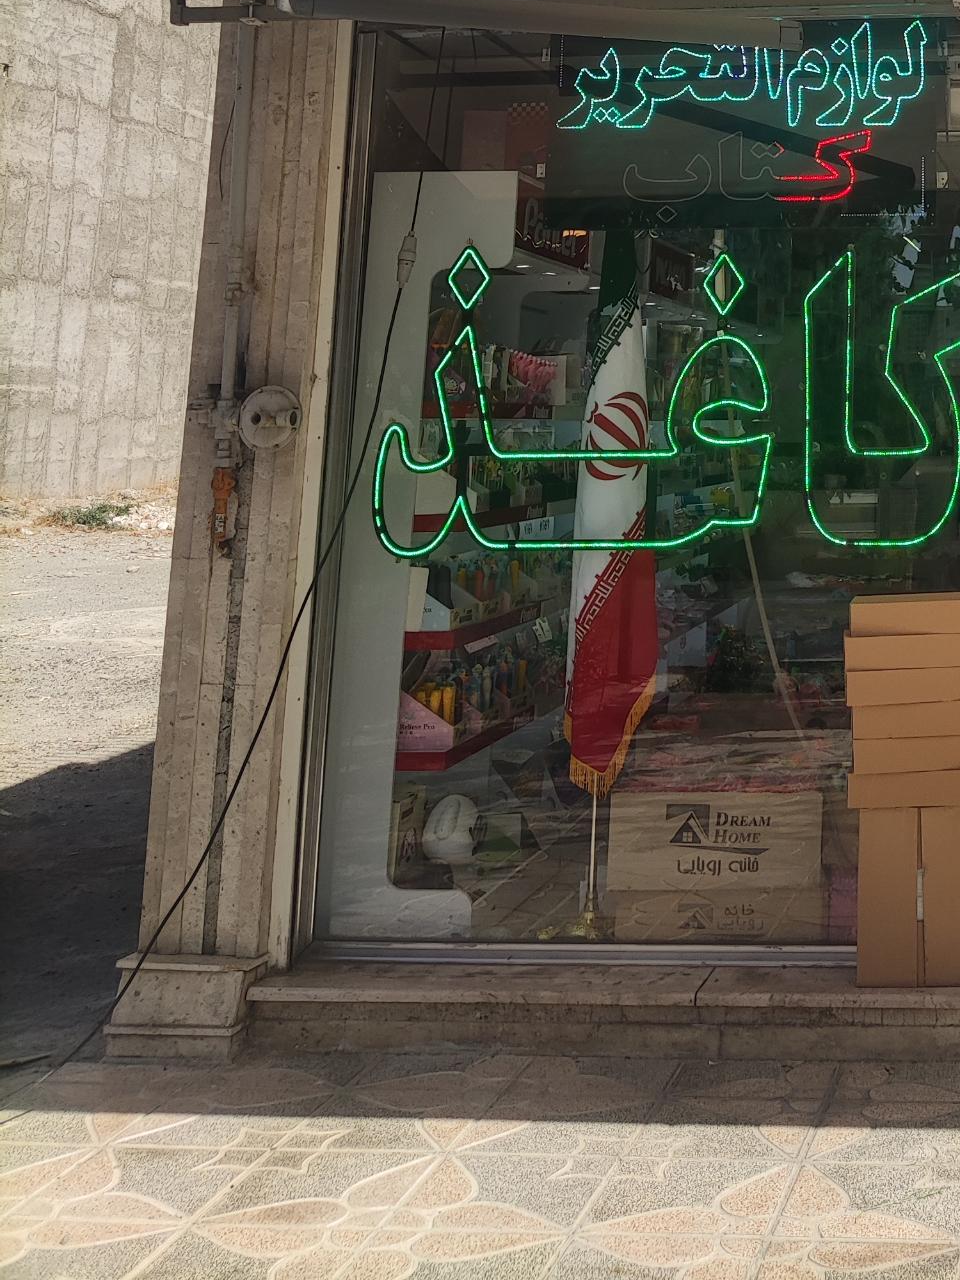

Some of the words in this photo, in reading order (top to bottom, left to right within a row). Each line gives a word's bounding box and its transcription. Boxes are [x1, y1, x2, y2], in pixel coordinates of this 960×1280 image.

[555, 44, 784, 129] التحریر
[786, 19, 928, 127] لوازم
[622, 129, 873, 223] کتاب
[712, 829, 761, 844] HOME
[715, 811, 771, 827] DREAM
